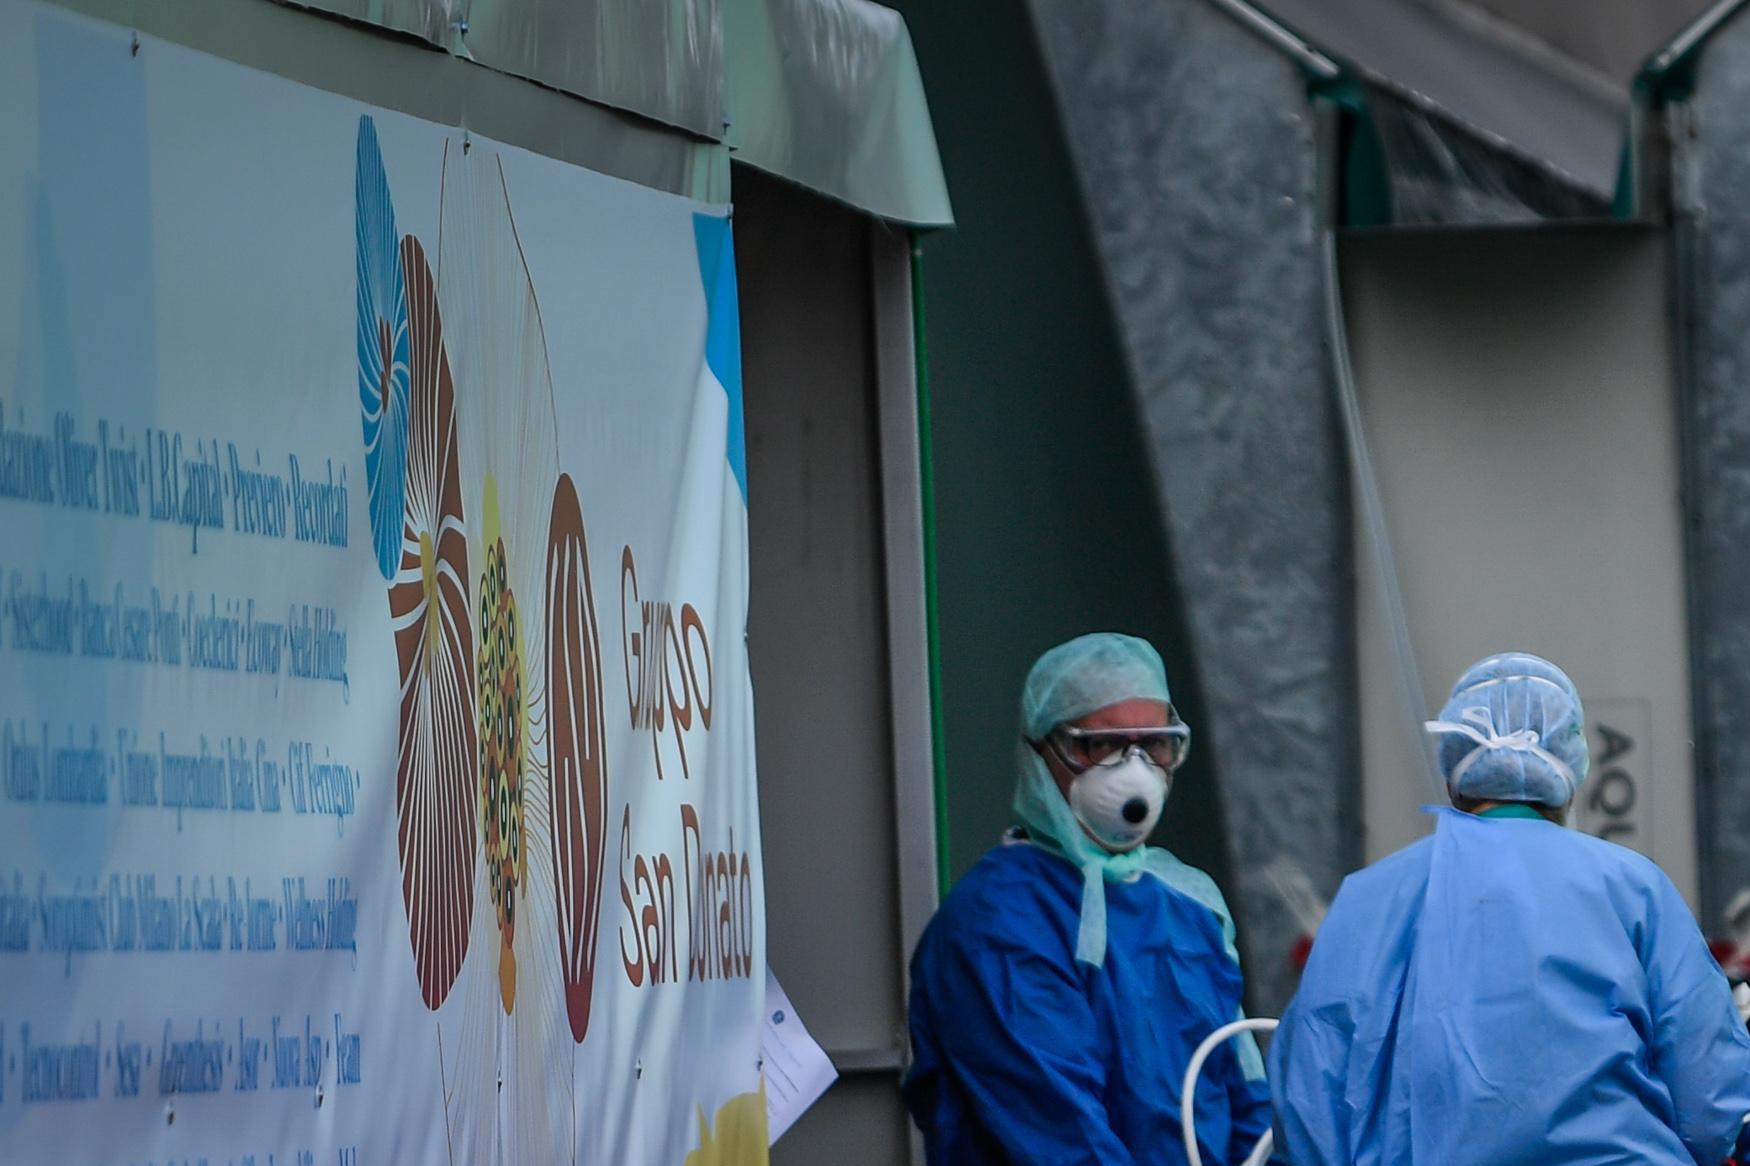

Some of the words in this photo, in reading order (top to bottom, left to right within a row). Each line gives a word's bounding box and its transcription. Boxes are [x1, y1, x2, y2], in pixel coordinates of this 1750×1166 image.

[288, 453, 348, 547] Recordati
[622, 545, 712, 779] Gruppo
[620, 802, 678, 987] San
[680, 803, 752, 982] Donato
